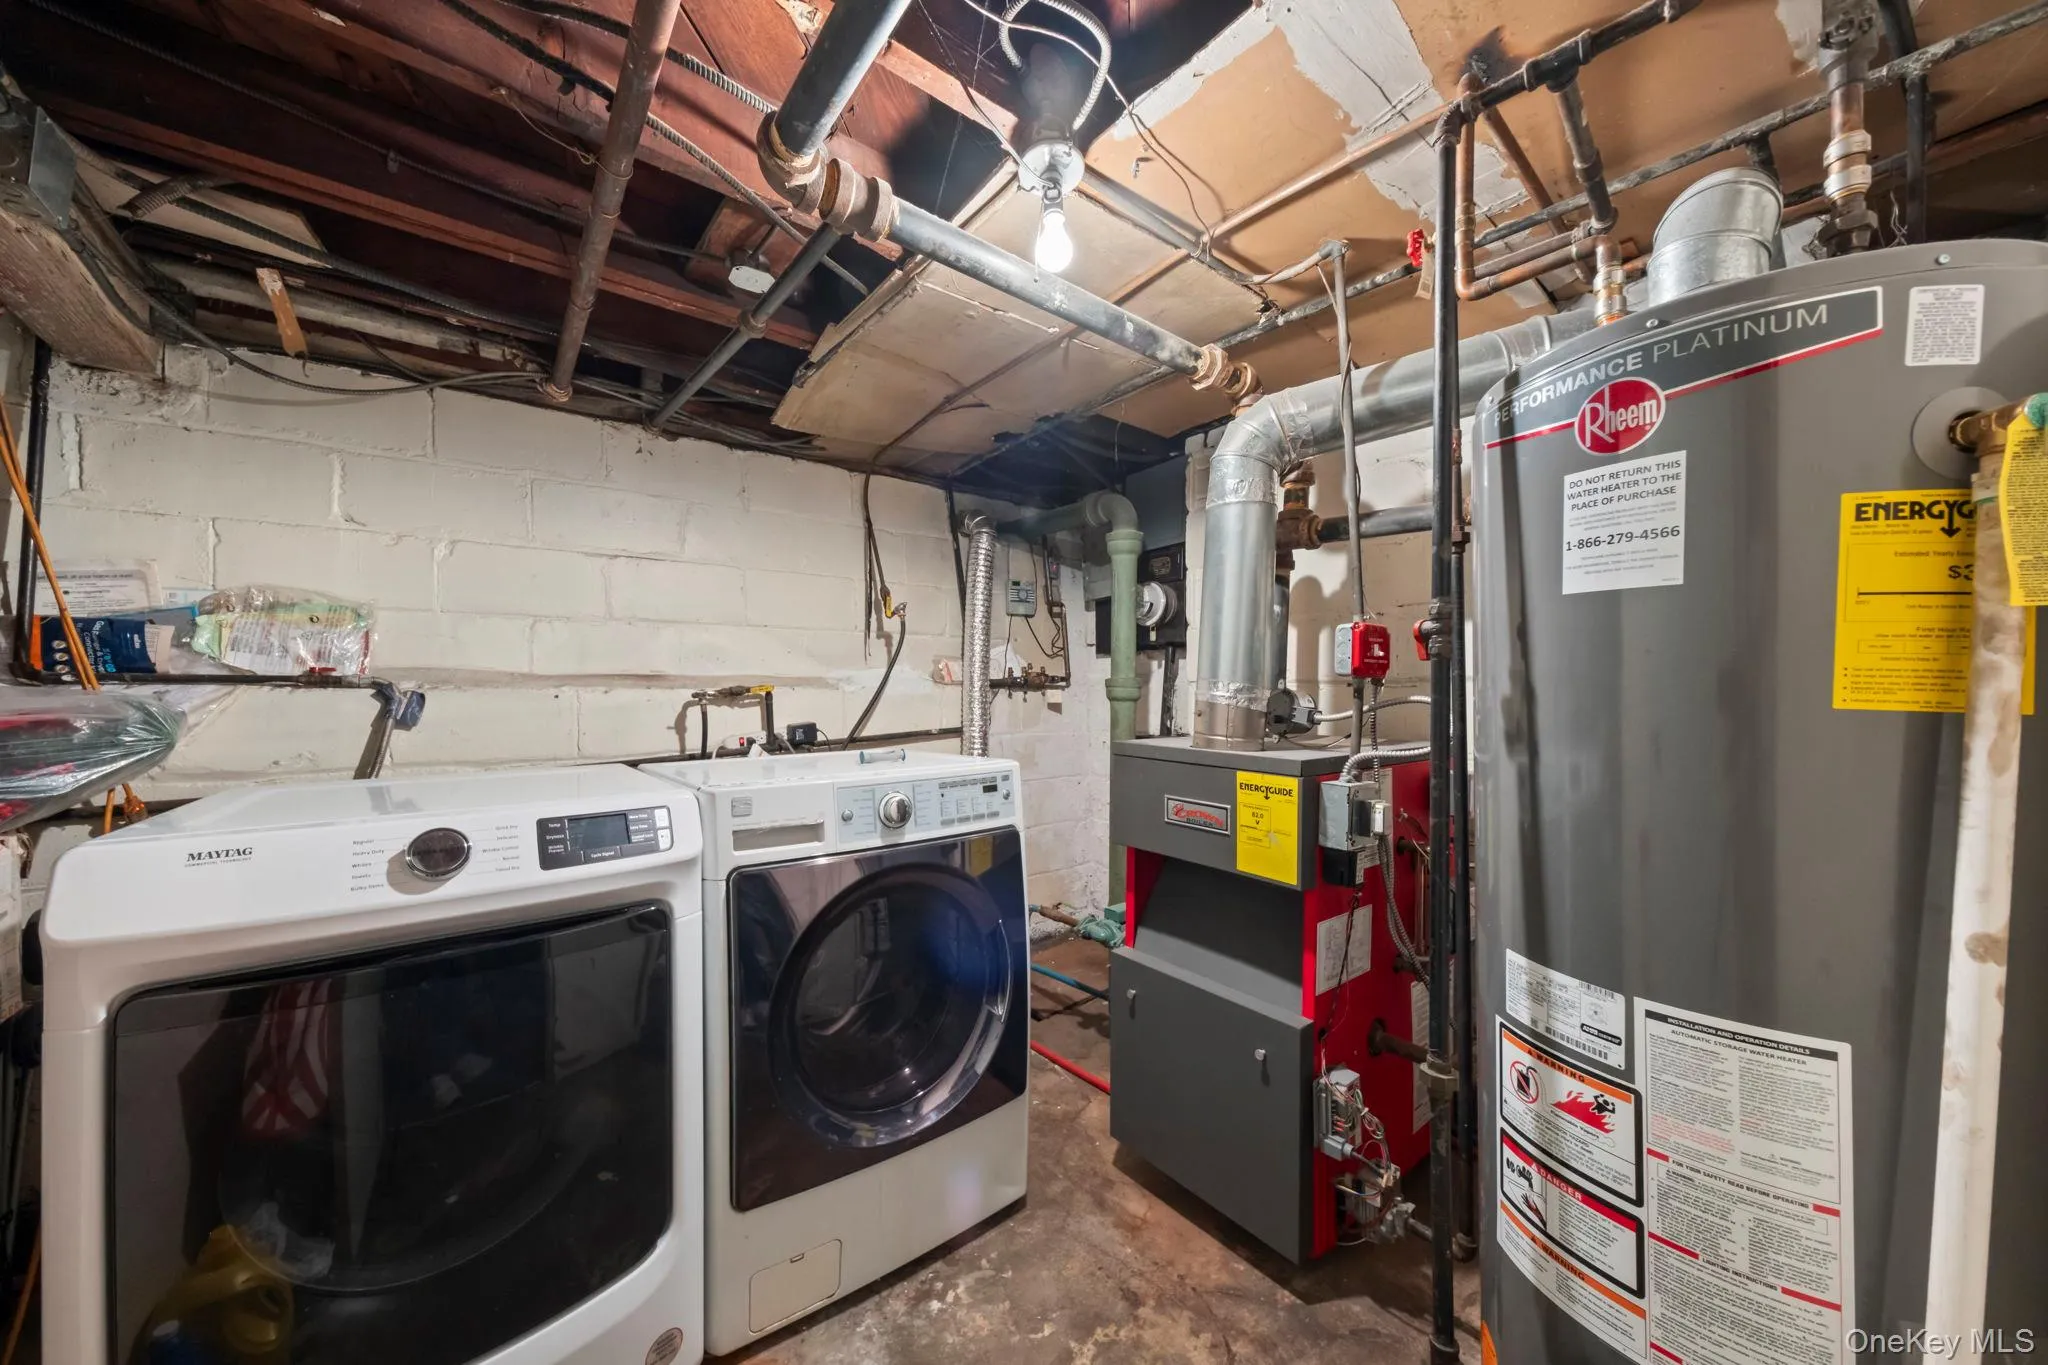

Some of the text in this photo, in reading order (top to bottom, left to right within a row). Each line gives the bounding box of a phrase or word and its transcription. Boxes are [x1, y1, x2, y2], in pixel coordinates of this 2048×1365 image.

[1494, 352, 1642, 427] PERFORMANCE
[1653, 303, 1829, 364] PLATINUM
[1585, 386, 1658, 449] Rheem
[1567, 472, 1682, 501] WATER HEATER TO THE
[1569, 459, 1681, 489] DO NOT RETURN THIS
[1571, 485, 1677, 512] PLACE OF PURCHASE
[1565, 525, 1681, 552] 1-866-279-4566
[1240, 783, 1293, 797] ENERGYGUIDE
[187, 847, 252, 862] MAYTAG
[1667, 1017, 1810, 1055] INSTALLATION AND OPERATION DETAILS
[1671, 1029, 1807, 1066] AUTOMATIC STORAGE WATER HEATER
[1536, 1053, 1585, 1082] WARNING
[1540, 1169, 1582, 1201] DANGER
[1672, 1159, 1810, 1209] FOR YOUR SAFETY READ BEFORE OPERATING
[1541, 1244, 1585, 1281] WARNING
[1702, 1257, 1778, 1291] LIGHTING INSTRUCTIONS
